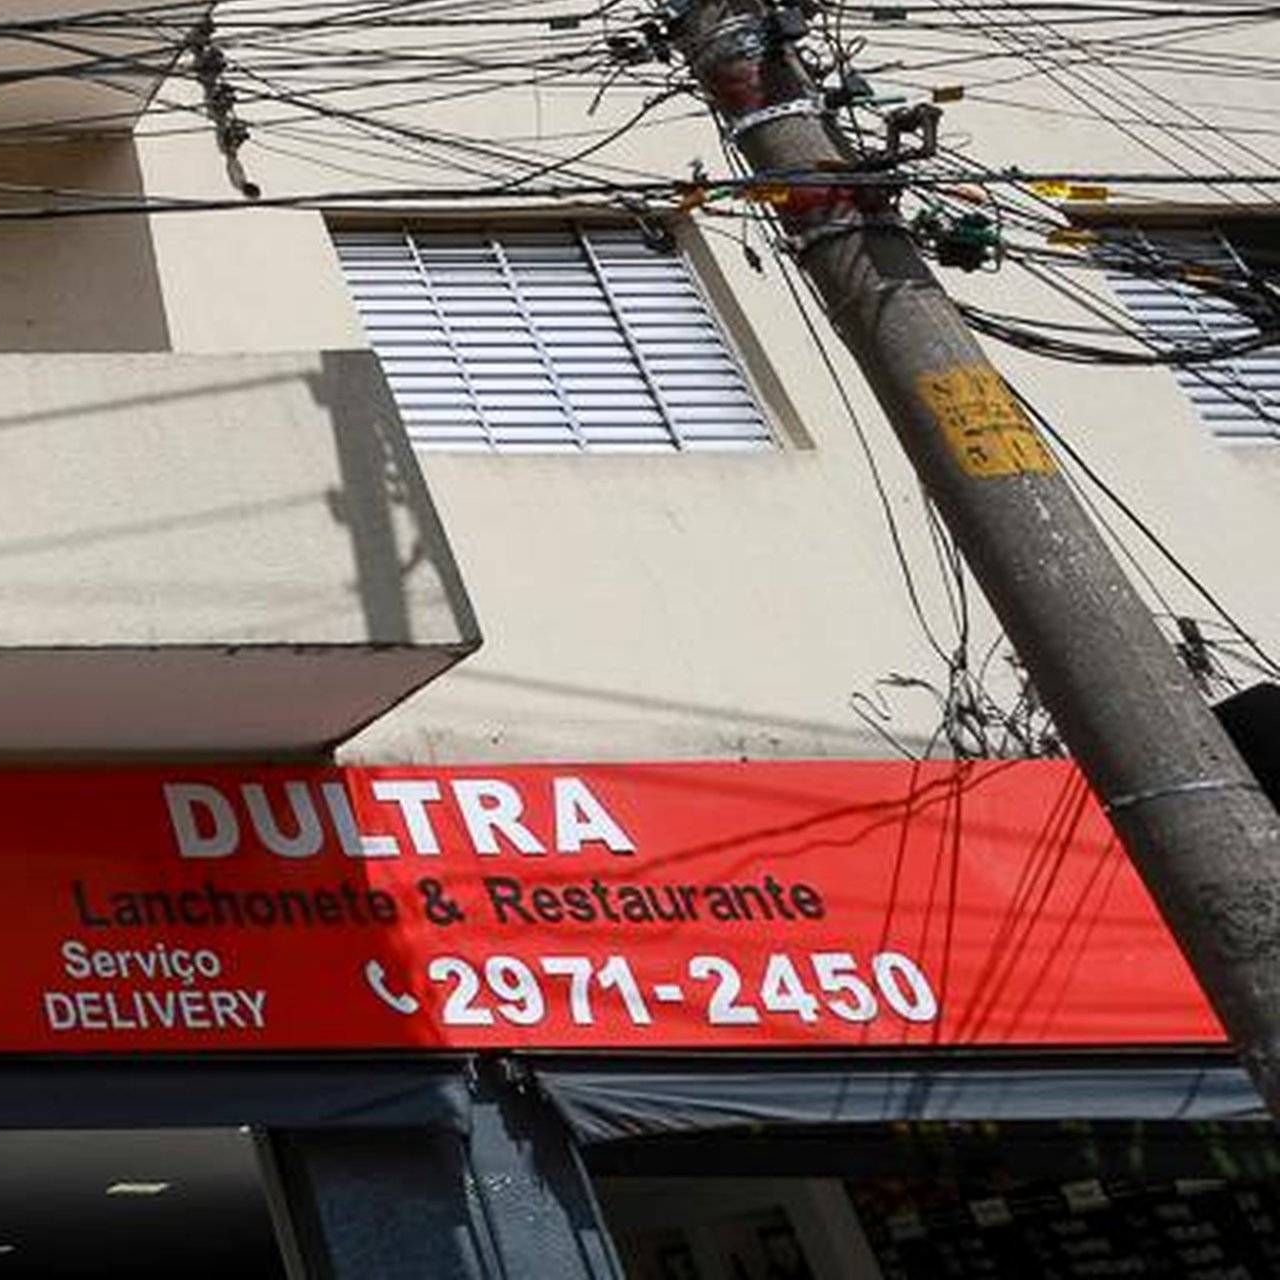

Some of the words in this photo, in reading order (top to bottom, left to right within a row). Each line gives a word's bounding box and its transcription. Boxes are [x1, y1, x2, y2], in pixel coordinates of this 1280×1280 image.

[163, 777, 636, 858] DULTRA
[73, 877, 397, 928] Lanchonete
[418, 878, 465, 926] &
[485, 874, 827, 926] Restaurante
[61, 941, 221, 987] Serviço
[427, 953, 939, 1026] 2971-2450
[45, 990, 268, 1031] DELIVERY
